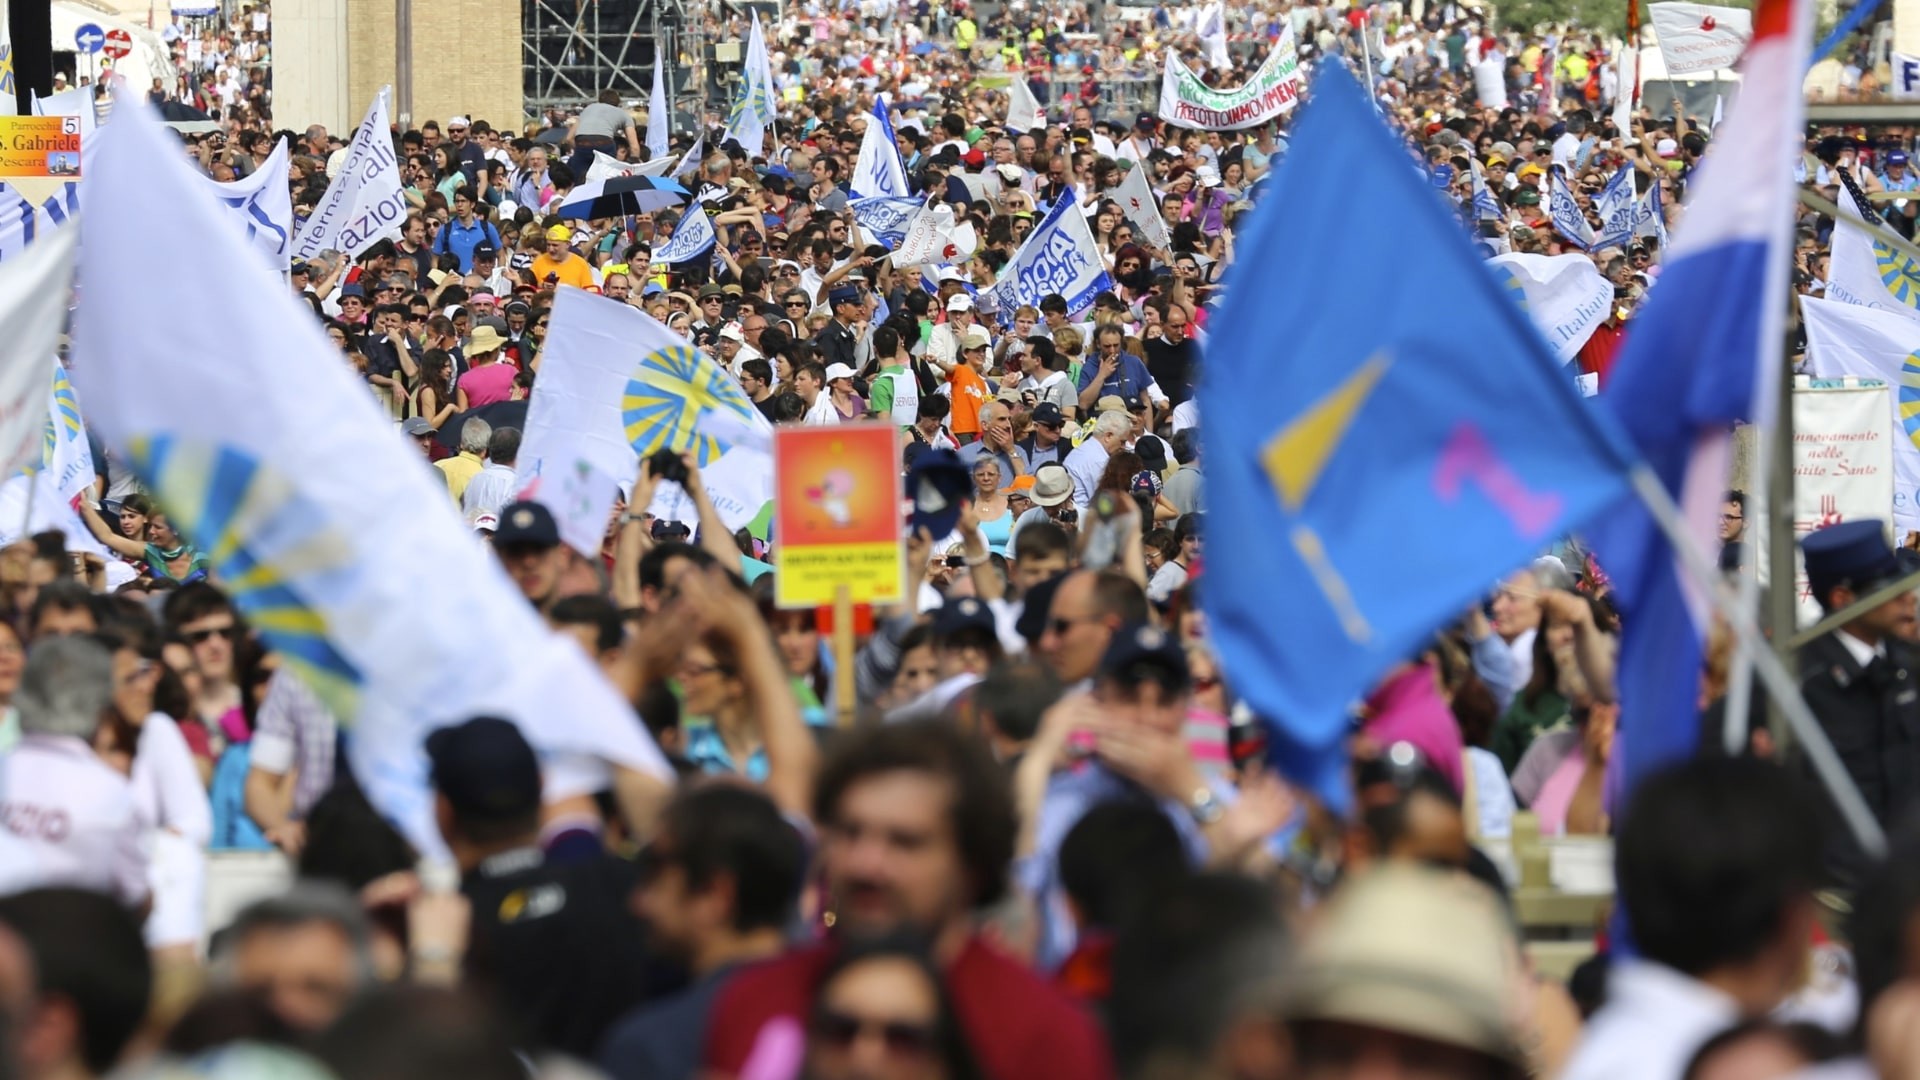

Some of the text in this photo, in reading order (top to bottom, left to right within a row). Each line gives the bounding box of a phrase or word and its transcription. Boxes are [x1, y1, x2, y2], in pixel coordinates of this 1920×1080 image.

[11, 121, 62, 131] Parrocchia
[65, 118, 76, 134] 5
[13, 134, 79, 151] Gabriele
[298, 111, 378, 259] nternazionale
[1825, 279, 1863, 305] zione
[1553, 283, 1610, 341] Italiana
[895, 396, 917, 407] SERVIZIO
[1793, 430, 1879, 443] innovamento
[1793, 459, 1878, 477] irito Santo
